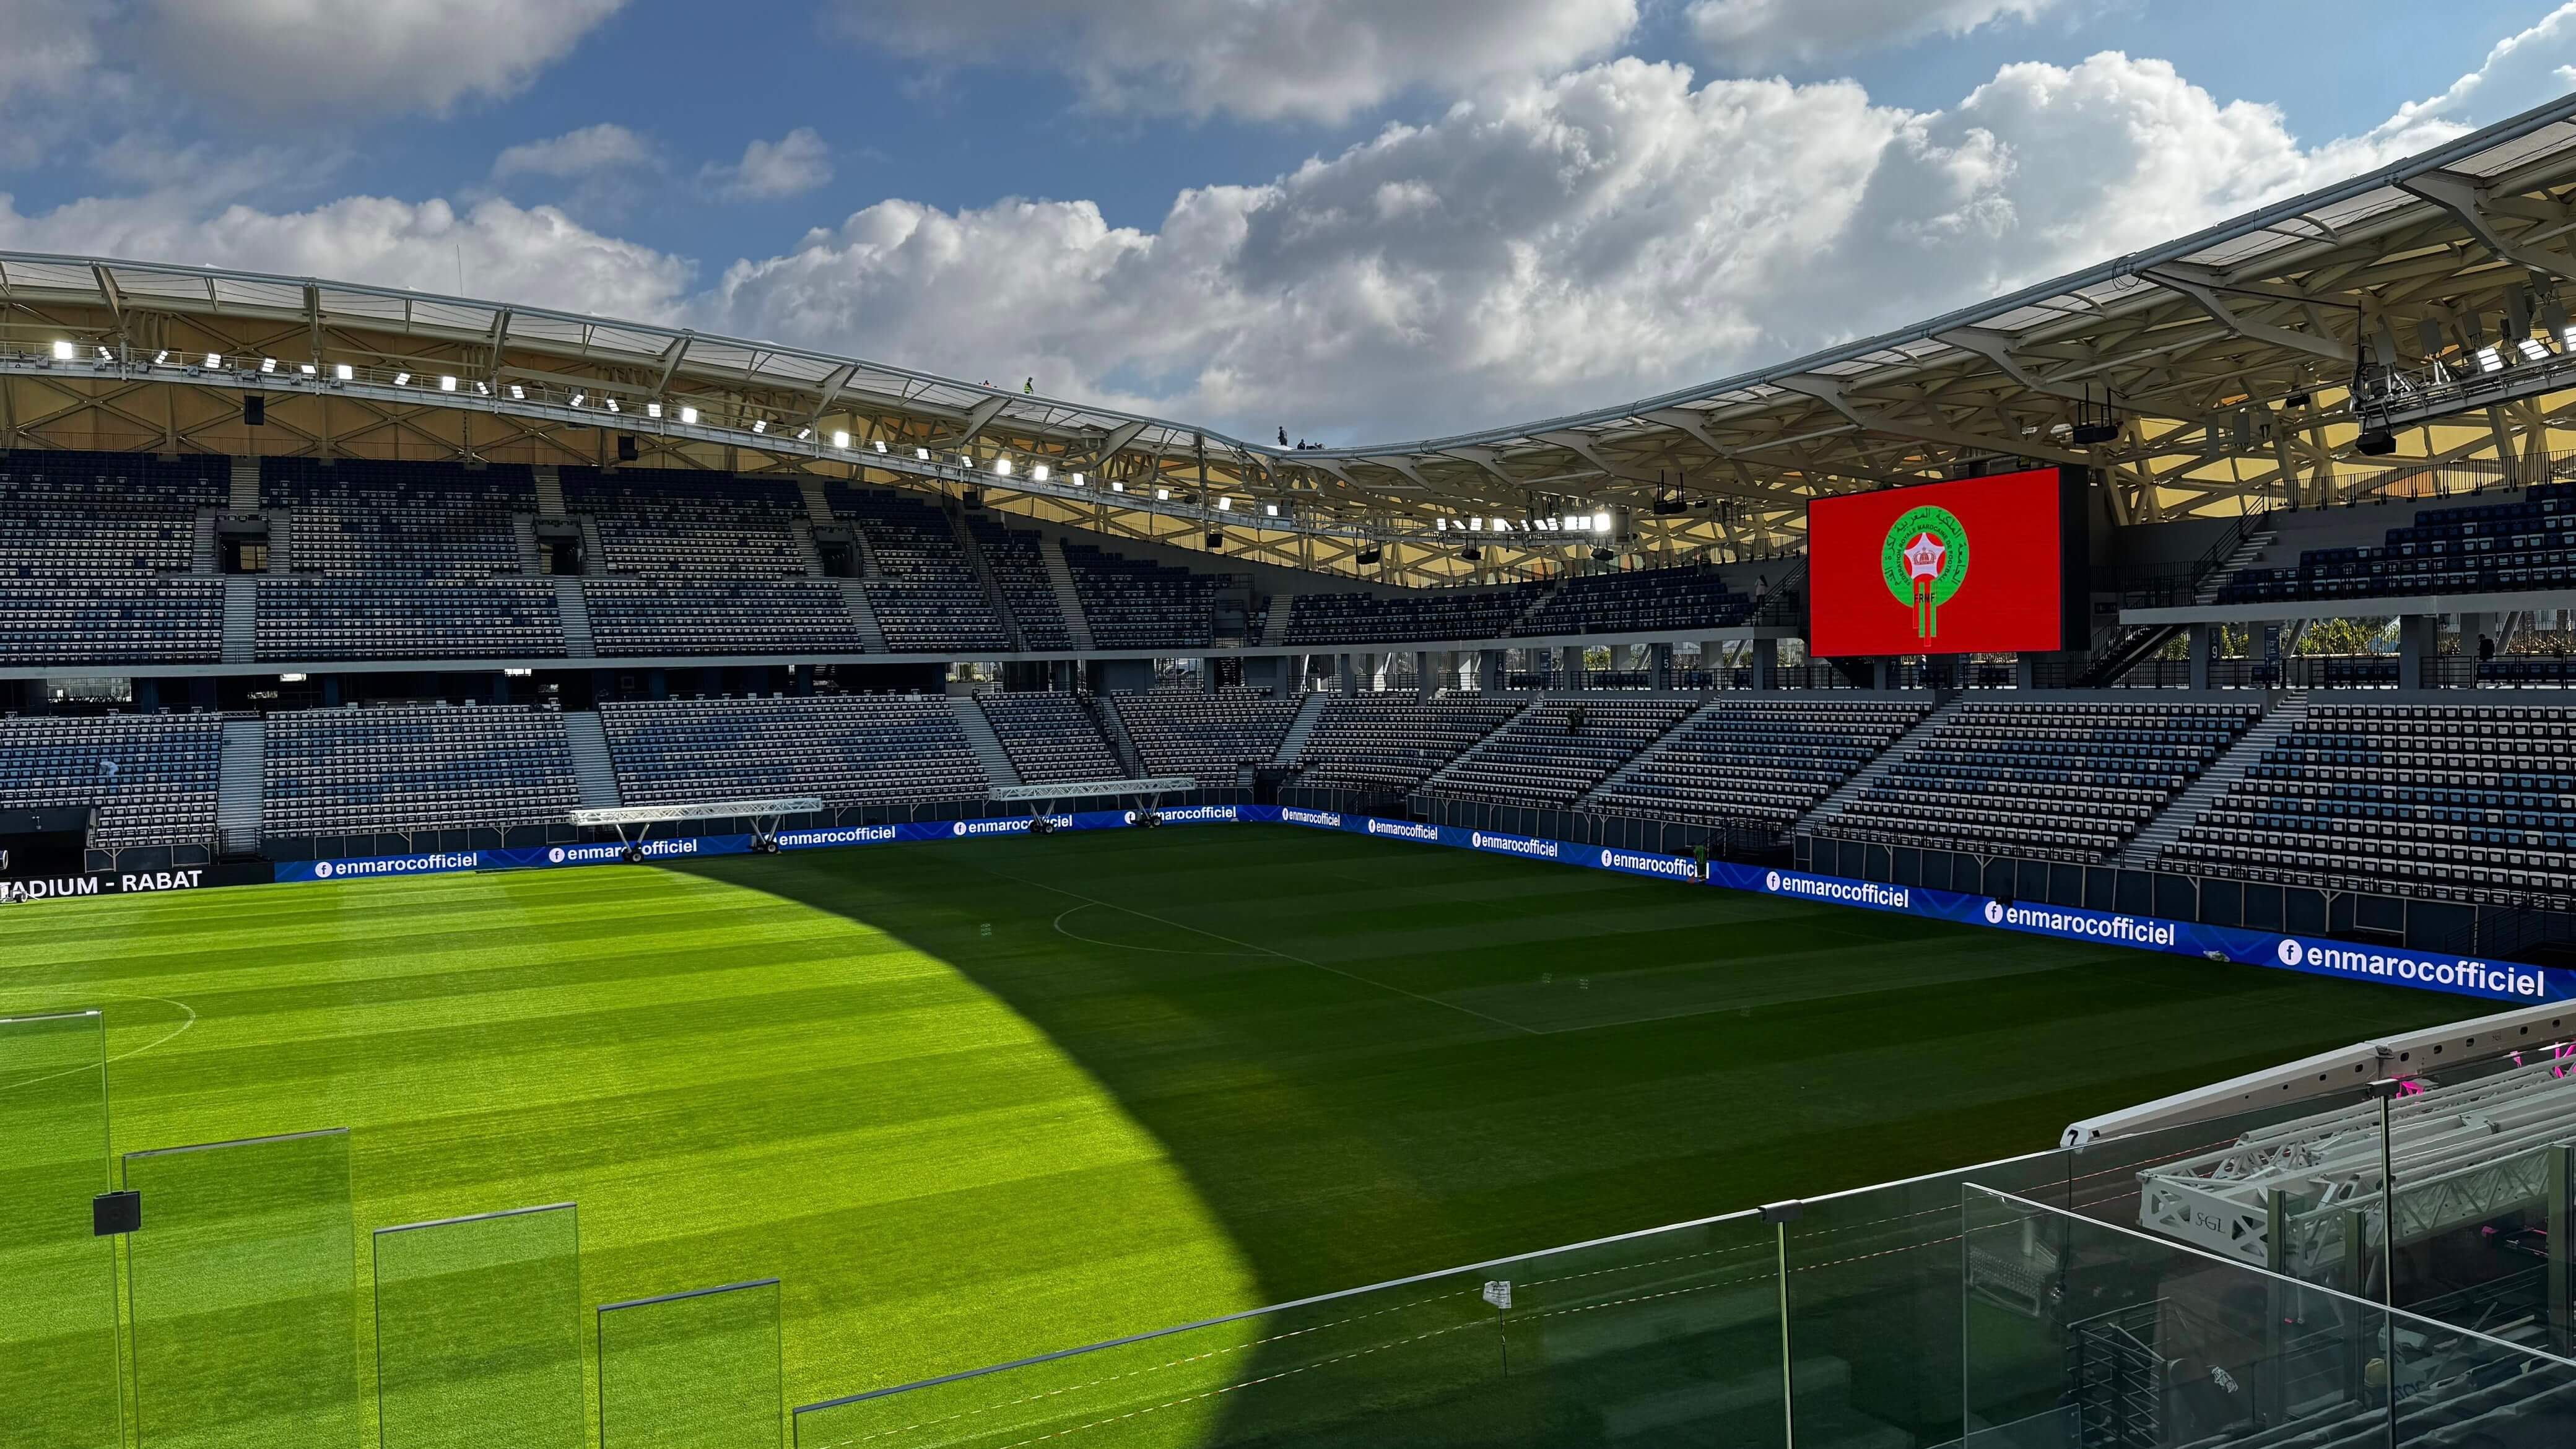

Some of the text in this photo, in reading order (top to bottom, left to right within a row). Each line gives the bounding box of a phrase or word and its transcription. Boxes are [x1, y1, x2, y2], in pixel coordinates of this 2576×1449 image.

[1914, 593, 1935, 603] FRMF
[2212, 646, 2217, 659] 9
[1664, 659, 1669, 669] 5
[1289, 811, 1340, 827] enmarocofficiel
[780, 826, 895, 846] enmarocofficiel
[1377, 822, 1438, 840] enmarocofficiel
[1482, 836, 1558, 858] enmarocofficiel
[336, 853, 477, 875] enmarocofficiel
[1614, 855, 1710, 879] enmarocofficil
[123, 870, 202, 892] RABAT
[1783, 877, 1908, 908] enmarocofficiel
[2007, 908, 2175, 946] enmarocofficiel
[2308, 948, 2544, 997] enmarocofficiel
[2067, 1129, 2079, 1146] 7
